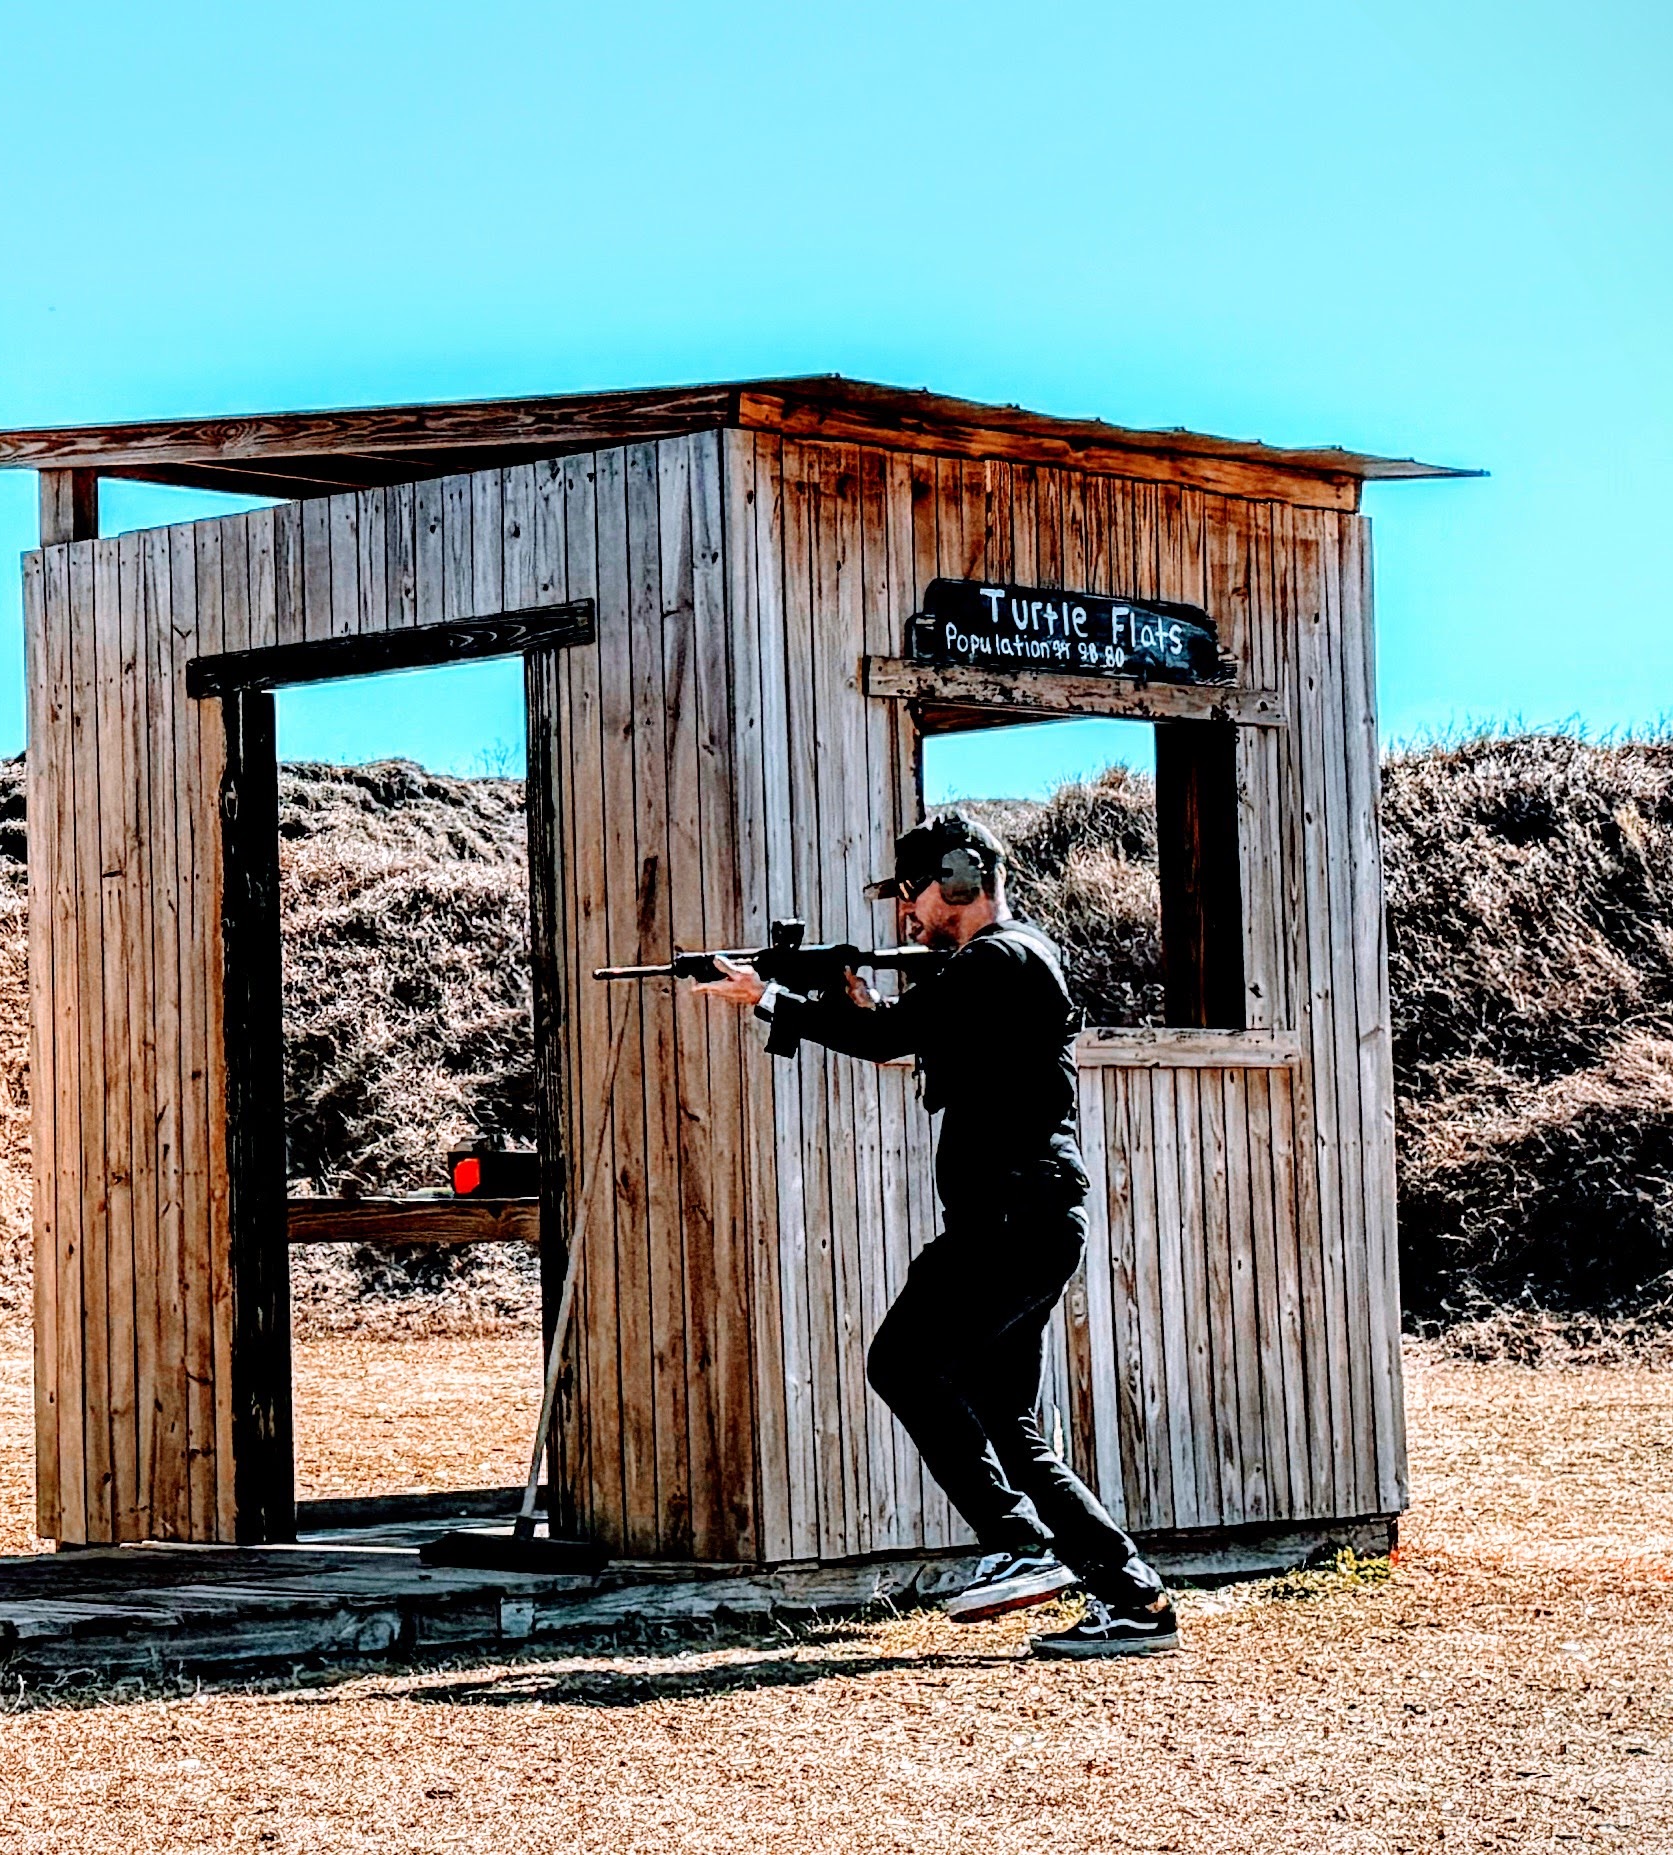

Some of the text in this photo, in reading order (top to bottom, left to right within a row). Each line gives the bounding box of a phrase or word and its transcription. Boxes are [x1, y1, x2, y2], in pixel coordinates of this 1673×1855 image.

[945, 621, 1050, 659] Population
[1105, 645, 1125, 667] 80
[980, 588, 1183, 655] Turtle Flats
